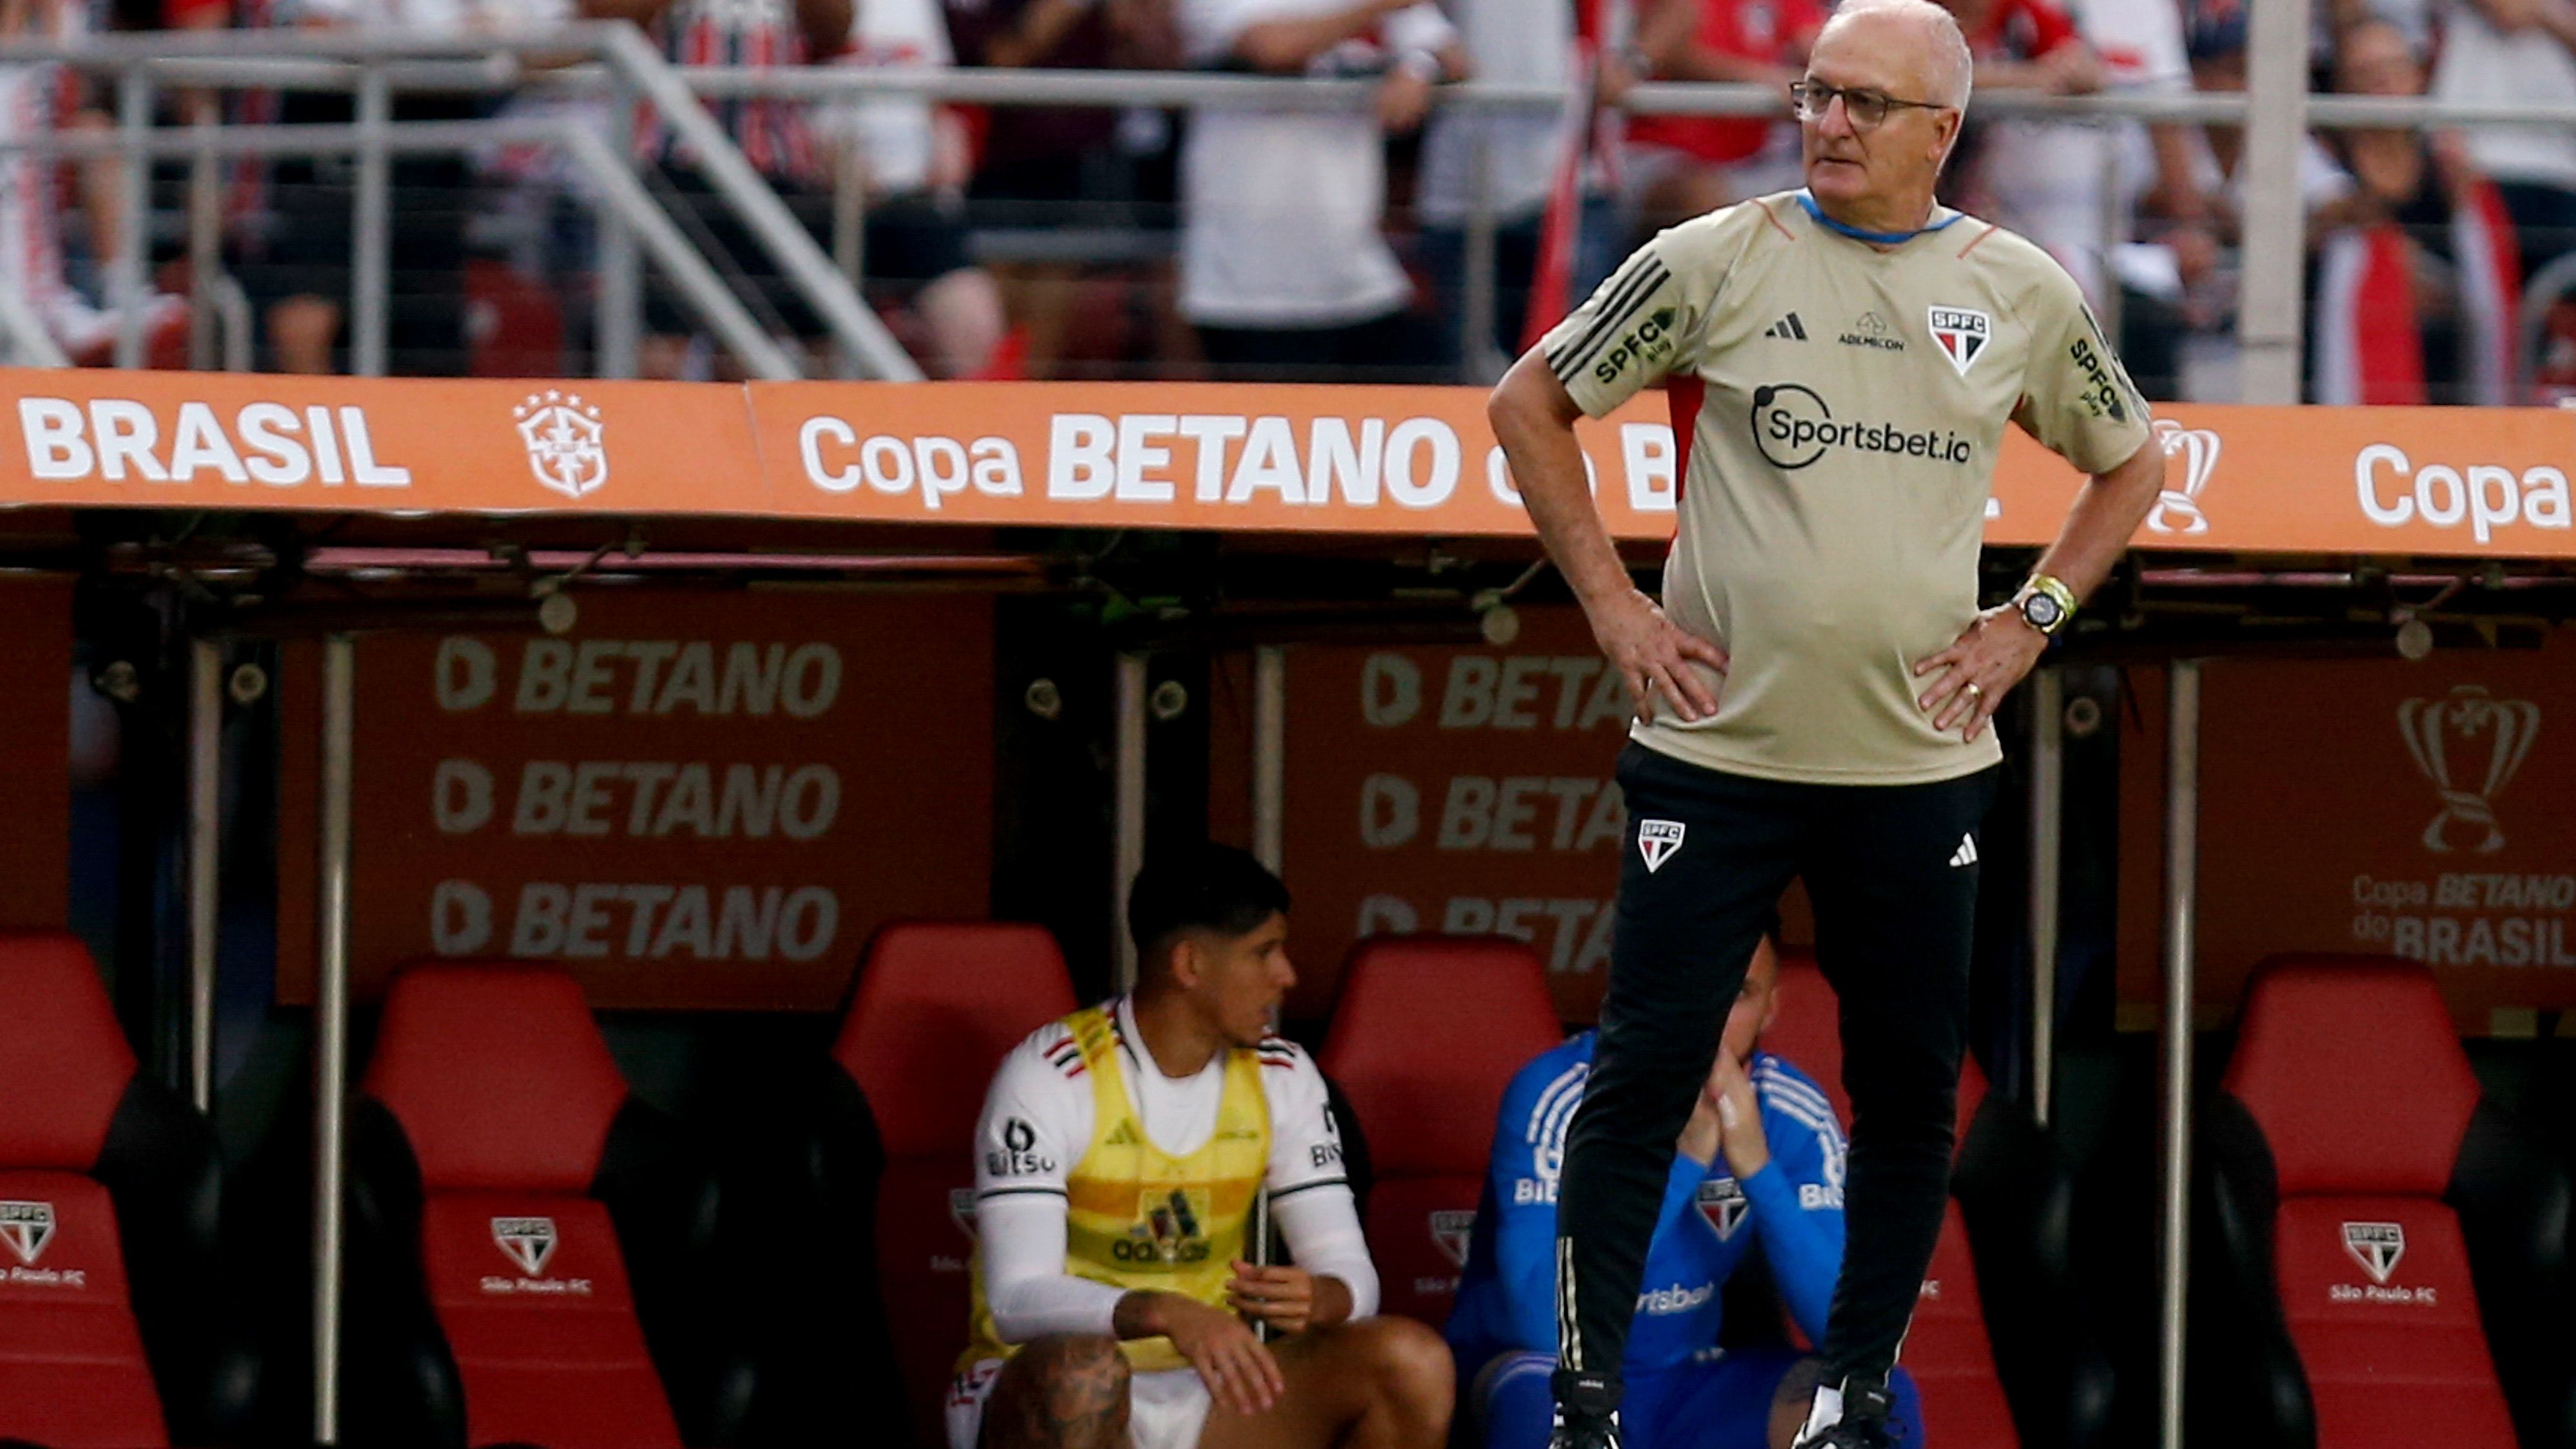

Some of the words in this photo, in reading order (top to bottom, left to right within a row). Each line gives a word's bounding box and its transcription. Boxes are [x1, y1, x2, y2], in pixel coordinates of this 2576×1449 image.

[1596, 321, 1660, 384] SPFC
[1933, 312, 1985, 333] SPFC
[2070, 338, 2116, 406] SPFC
[18, 397, 411, 487] BRASIL
[799, 416, 1024, 510] Copa
[1047, 413, 1461, 507] BETANO
[1768, 409, 1971, 464] Sportsbet.io
[2355, 442, 2572, 544] Copa
[516, 639, 842, 719] BETANO
[1437, 655, 1634, 730] BETA
[513, 759, 841, 839] BETANO
[1436, 775, 1629, 853] BETA
[509, 882, 838, 961] BETANO
[2352, 873, 2429, 909] Copa
[2434, 871, 2576, 908] BETANO
[2352, 909, 2390, 940] do
[2393, 916, 2576, 967] BRASIL
